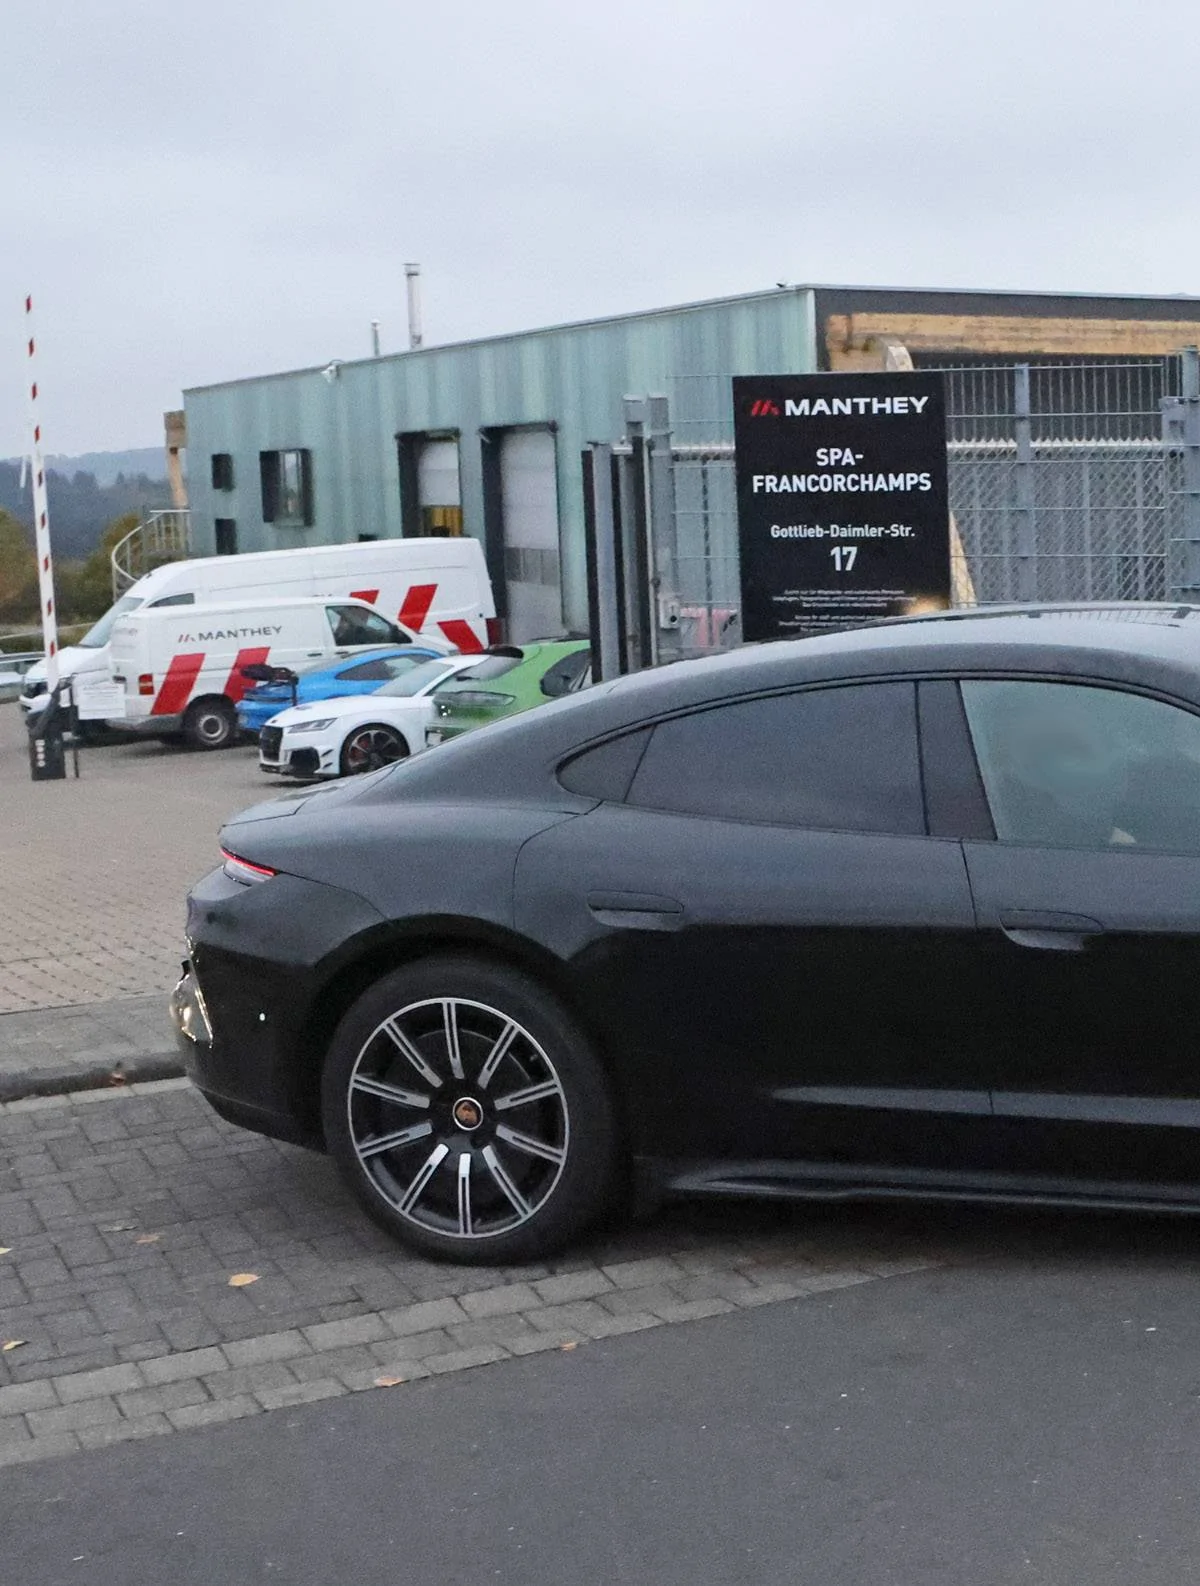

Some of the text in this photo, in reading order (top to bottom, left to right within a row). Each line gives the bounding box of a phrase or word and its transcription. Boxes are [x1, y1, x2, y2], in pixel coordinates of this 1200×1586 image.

[785, 396, 929, 416] MANTHEY
[816, 448, 864, 467] SPA-
[752, 473, 932, 493] FRANCORCHAMPS
[770, 524, 915, 538] Gottlieb-Daimler-Str.
[830, 546, 858, 571] 17
[198, 625, 282, 641] MANTHEY
